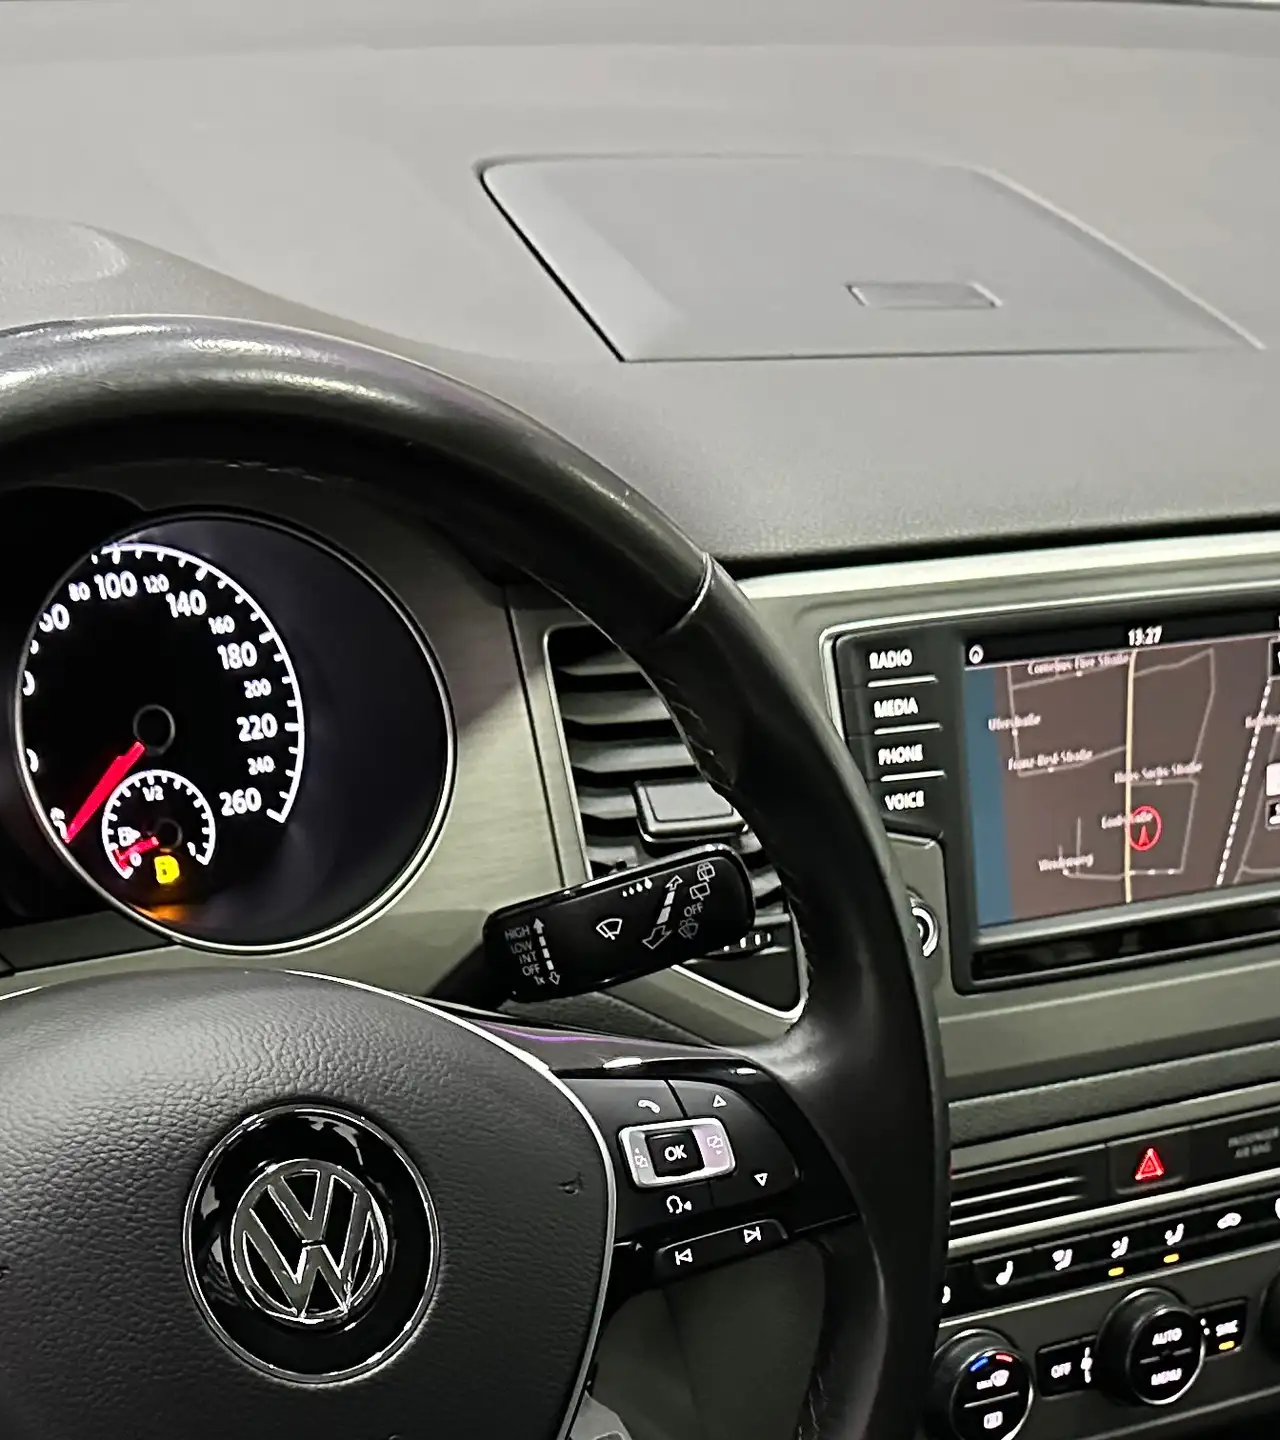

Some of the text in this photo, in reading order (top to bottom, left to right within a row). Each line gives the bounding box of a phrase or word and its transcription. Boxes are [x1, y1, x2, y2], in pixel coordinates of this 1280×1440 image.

[68, 582, 91, 601] 80
[94, 570, 138, 600] 100
[143, 574, 170, 593] 120
[165, 589, 207, 618] 140
[208, 614, 235, 635] 160
[1128, 625, 1163, 646] 13:27
[217, 641, 258, 670] 180
[869, 648, 913, 670] RADIO
[244, 678, 272, 699] 200
[873, 696, 919, 719] MEDIA
[236, 712, 278, 742] 220
[878, 743, 924, 766] PHONE
[247, 755, 275, 776] 240
[219, 787, 263, 817] 260
[884, 790, 925, 812] VOICE
[683, 902, 703, 917] OFF
[504, 925, 530, 941] HIGH
[511, 940, 532, 954] LOW
[519, 950, 538, 964] INT
[522, 963, 541, 976] OFF
[664, 1143, 688, 1162] OK
[1152, 1327, 1182, 1346] AUTO
[1051, 1361, 1072, 1379] OFF
[1151, 1368, 1182, 1386] MENU
